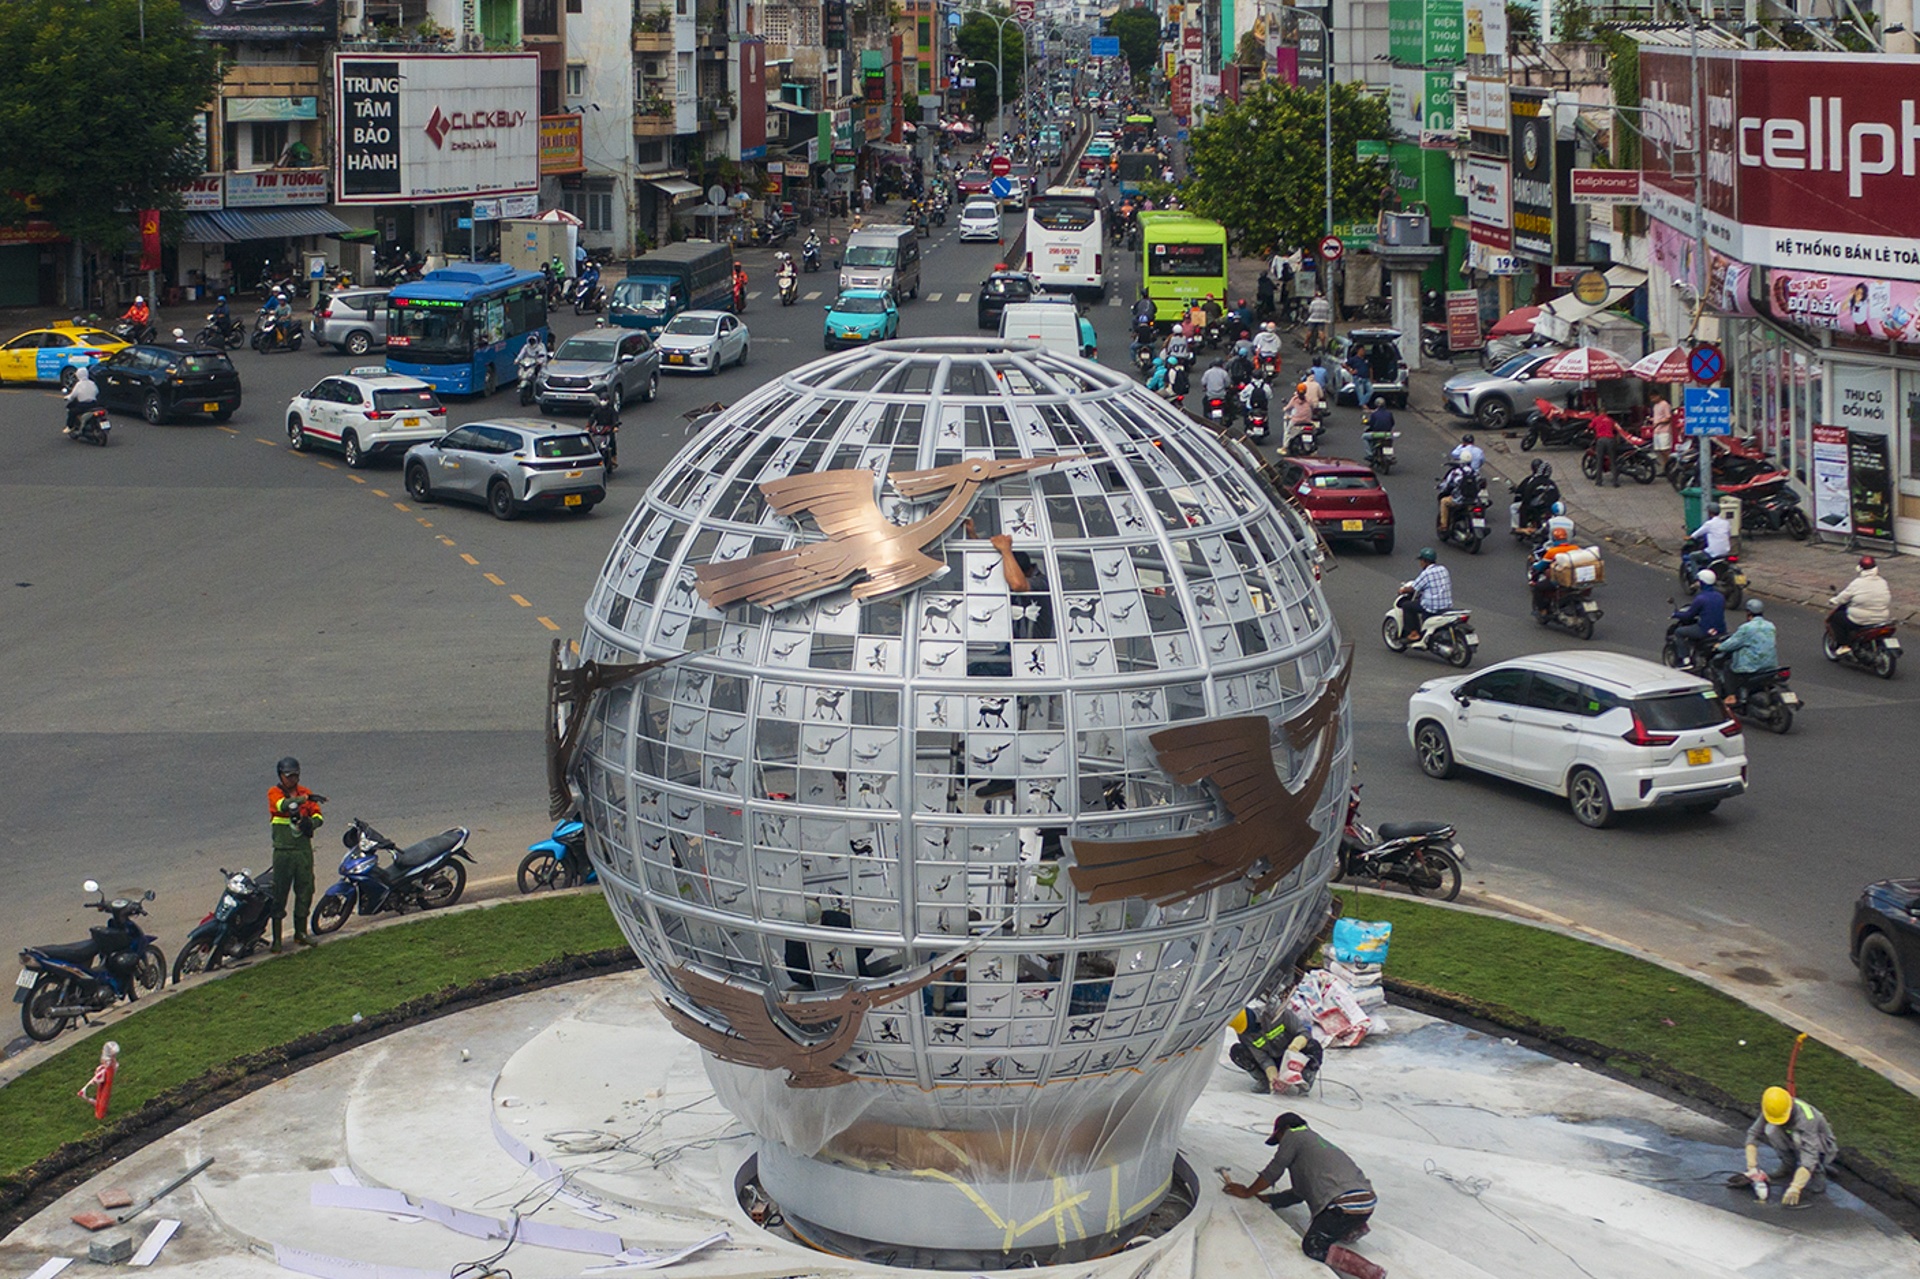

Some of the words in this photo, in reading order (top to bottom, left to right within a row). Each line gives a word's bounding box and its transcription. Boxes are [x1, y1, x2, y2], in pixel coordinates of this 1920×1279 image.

[1433, 17, 1457, 28] ĐIỆN
[1430, 31, 1461, 41] THOẠI
[1433, 43, 1456, 52] MÁY
[344, 77, 399, 93] TRUNG
[354, 98, 391, 117] TÂM
[451, 111, 527, 130] CLICKBUY
[354, 121, 390, 144] BẢO
[348, 151, 397, 170] HÀNH
[255, 174, 278, 188] TIN
[1776, 238, 1792, 256] HỆ
[1796, 238, 1841, 258] THỐNG
[1845, 243, 1872, 260] BÁN
[1875, 246, 1891, 262] LẺ
[1172, 344, 1186, 353] 07
[1845, 389, 1865, 401] THU
[1867, 390, 1883, 403] CŨ
[1842, 402, 1863, 417] ĐỔI
[1864, 406, 1884, 420] MỚI
